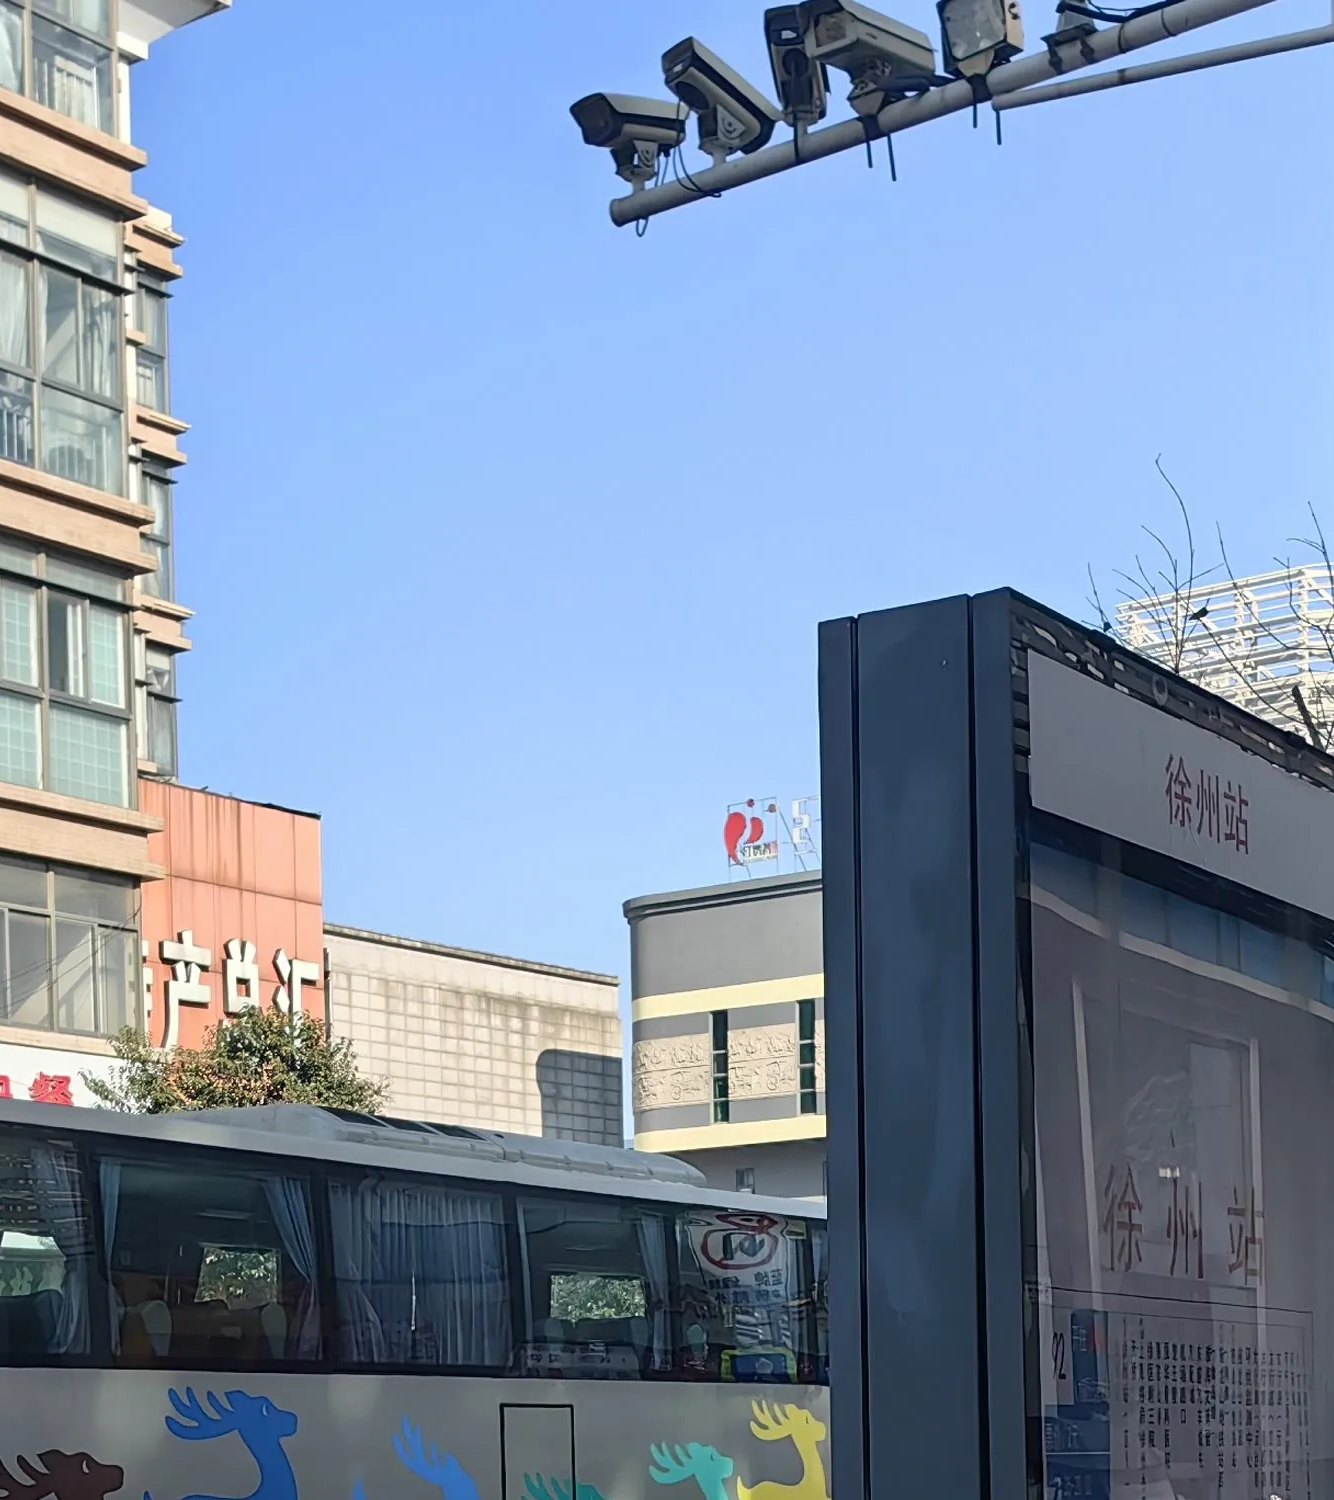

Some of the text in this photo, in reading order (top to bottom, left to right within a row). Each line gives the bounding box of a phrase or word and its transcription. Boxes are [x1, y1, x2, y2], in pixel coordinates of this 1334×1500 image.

[1164, 753, 1249, 855] 徐州站
[1103, 1163, 1264, 1285] 徐州站
